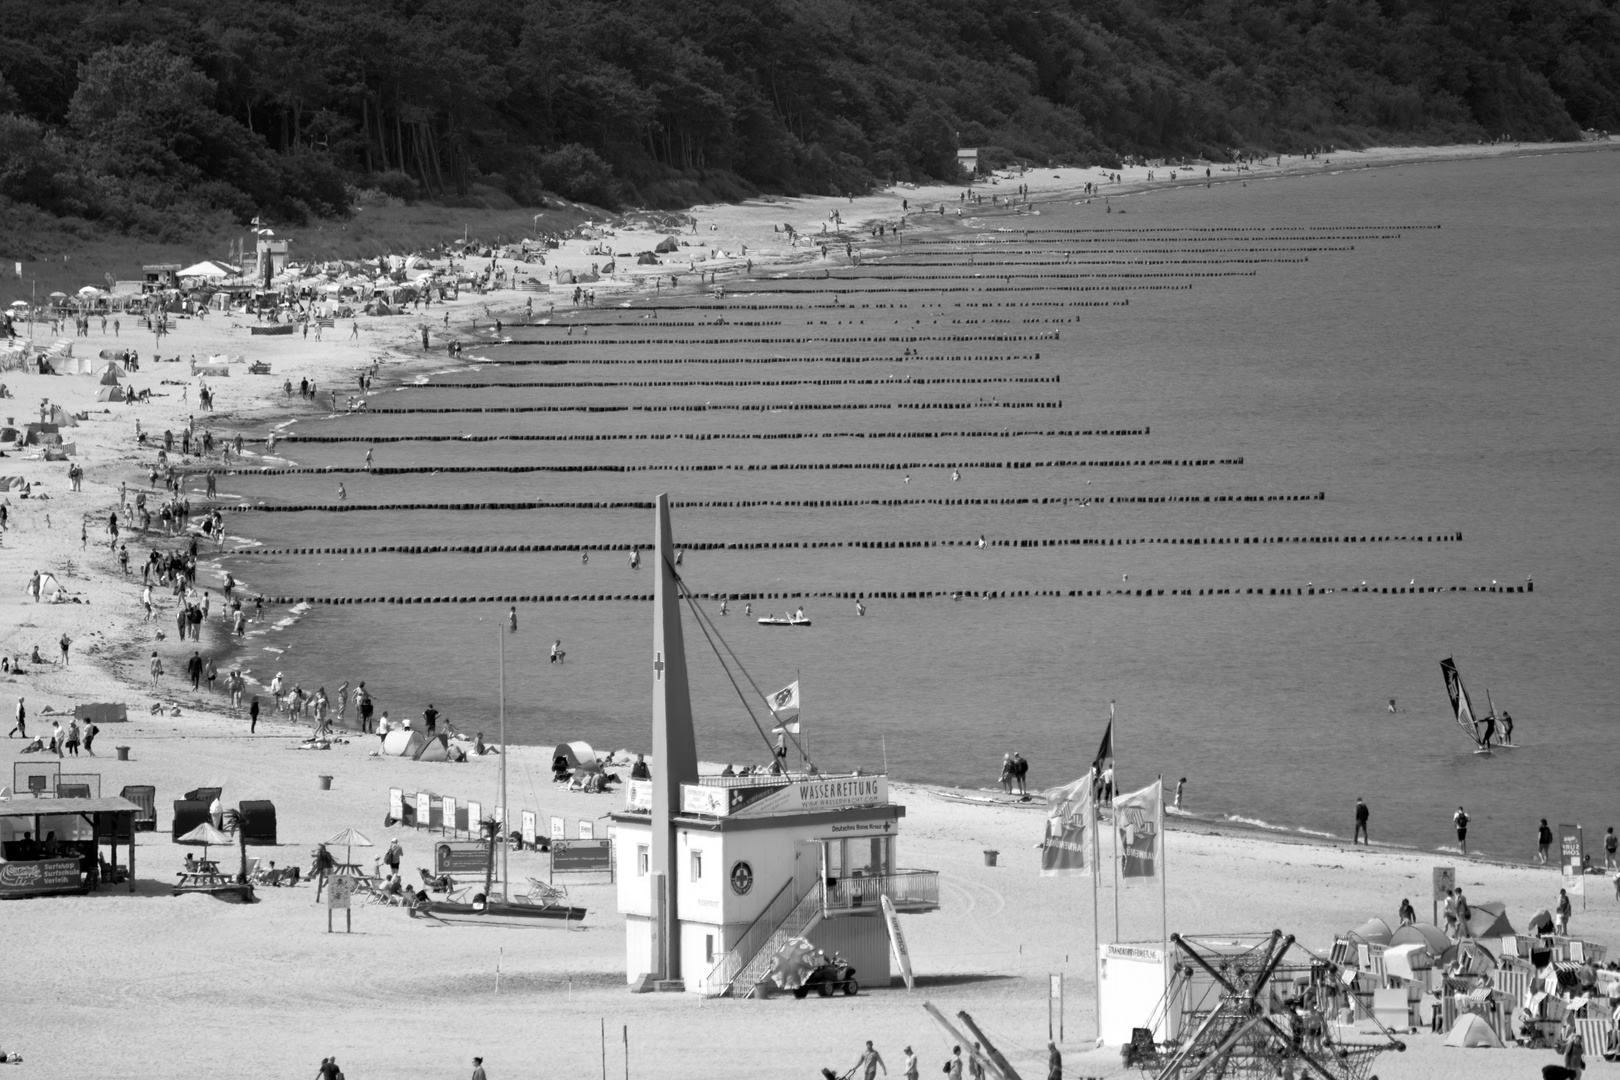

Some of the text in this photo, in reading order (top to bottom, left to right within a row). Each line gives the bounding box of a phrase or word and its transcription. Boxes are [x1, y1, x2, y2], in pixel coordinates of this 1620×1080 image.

[800, 781, 878, 800] WASSERRETTUNG
[44, 862, 75, 870] Surfshop
[44, 868, 80, 877] Surfschule
[44, 876, 69, 884] Verleih
